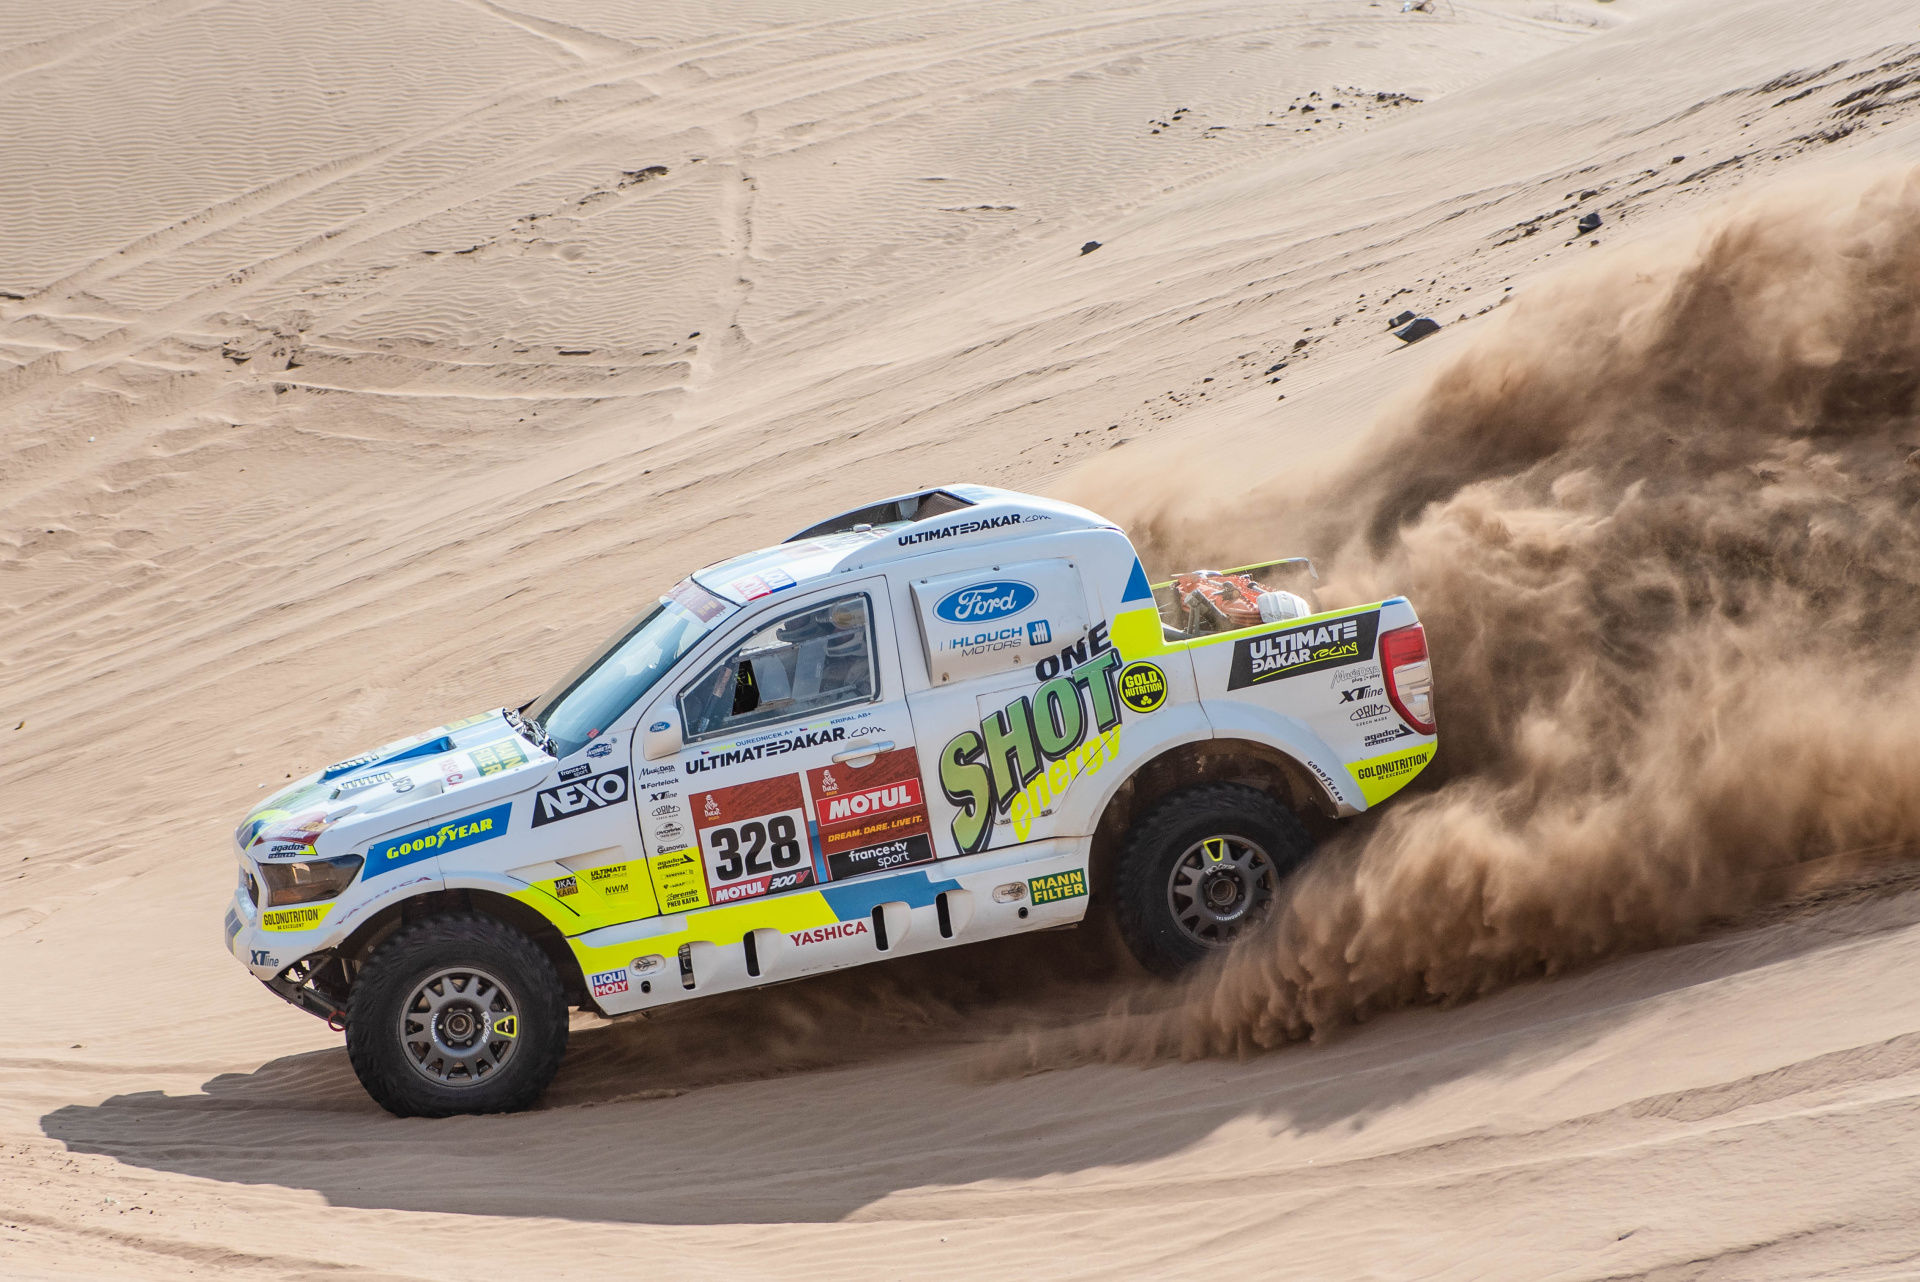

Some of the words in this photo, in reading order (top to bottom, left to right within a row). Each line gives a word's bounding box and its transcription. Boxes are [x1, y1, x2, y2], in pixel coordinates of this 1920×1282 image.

[954, 586, 1016, 619] Ford
[952, 627, 1022, 649] HLOUCH
[1250, 620, 1358, 659] ULTIMATE
[961, 639, 1021, 657] MOTORS
[1035, 619, 1112, 682] ONE
[1252, 649, 1311, 673] DAKAR
[1312, 641, 1359, 659] racing
[1125, 681, 1162, 698] NUTRITION
[1339, 685, 1383, 704] XTline
[830, 715, 856, 725] KRIPAL
[1354, 704, 1385, 720] PRIM
[735, 731, 783, 747] OUREDNICEK
[1364, 728, 1400, 742] agados
[939, 647, 1123, 855] SHOT
[1358, 751, 1428, 780] GOLDNUTRITION
[1385, 768, 1412, 779] EXCELLENT
[646, 778, 679, 789] Fortelock
[1011, 723, 1122, 843] energy
[1307, 761, 1343, 801] GOODYEAR
[540, 773, 625, 818] NEXO
[649, 790, 678, 802] XTline
[829, 785, 911, 820] MOTUL
[828, 830, 862, 842] DREAM.
[864, 822, 890, 834] DARE.
[891, 817, 911, 828] LIVE
[912, 815, 923, 823] IT.
[271, 842, 305, 853] agados
[387, 818, 493, 859] GOODYEAR
[711, 815, 800, 881] 328
[878, 851, 910, 869] sport
[591, 865, 626, 876] ULTIMATE
[605, 883, 629, 895] NWM
[716, 881, 765, 902] MOTUL
[769, 869, 809, 889] 300V
[1031, 871, 1083, 892] MANN
[1033, 883, 1085, 903] FILTER
[263, 909, 318, 926] GOLDNUTRITION
[790, 921, 868, 947] YASHICA
[250, 949, 279, 967] XTline
[593, 970, 626, 986] LIQUI
[595, 981, 628, 997] MOLY
